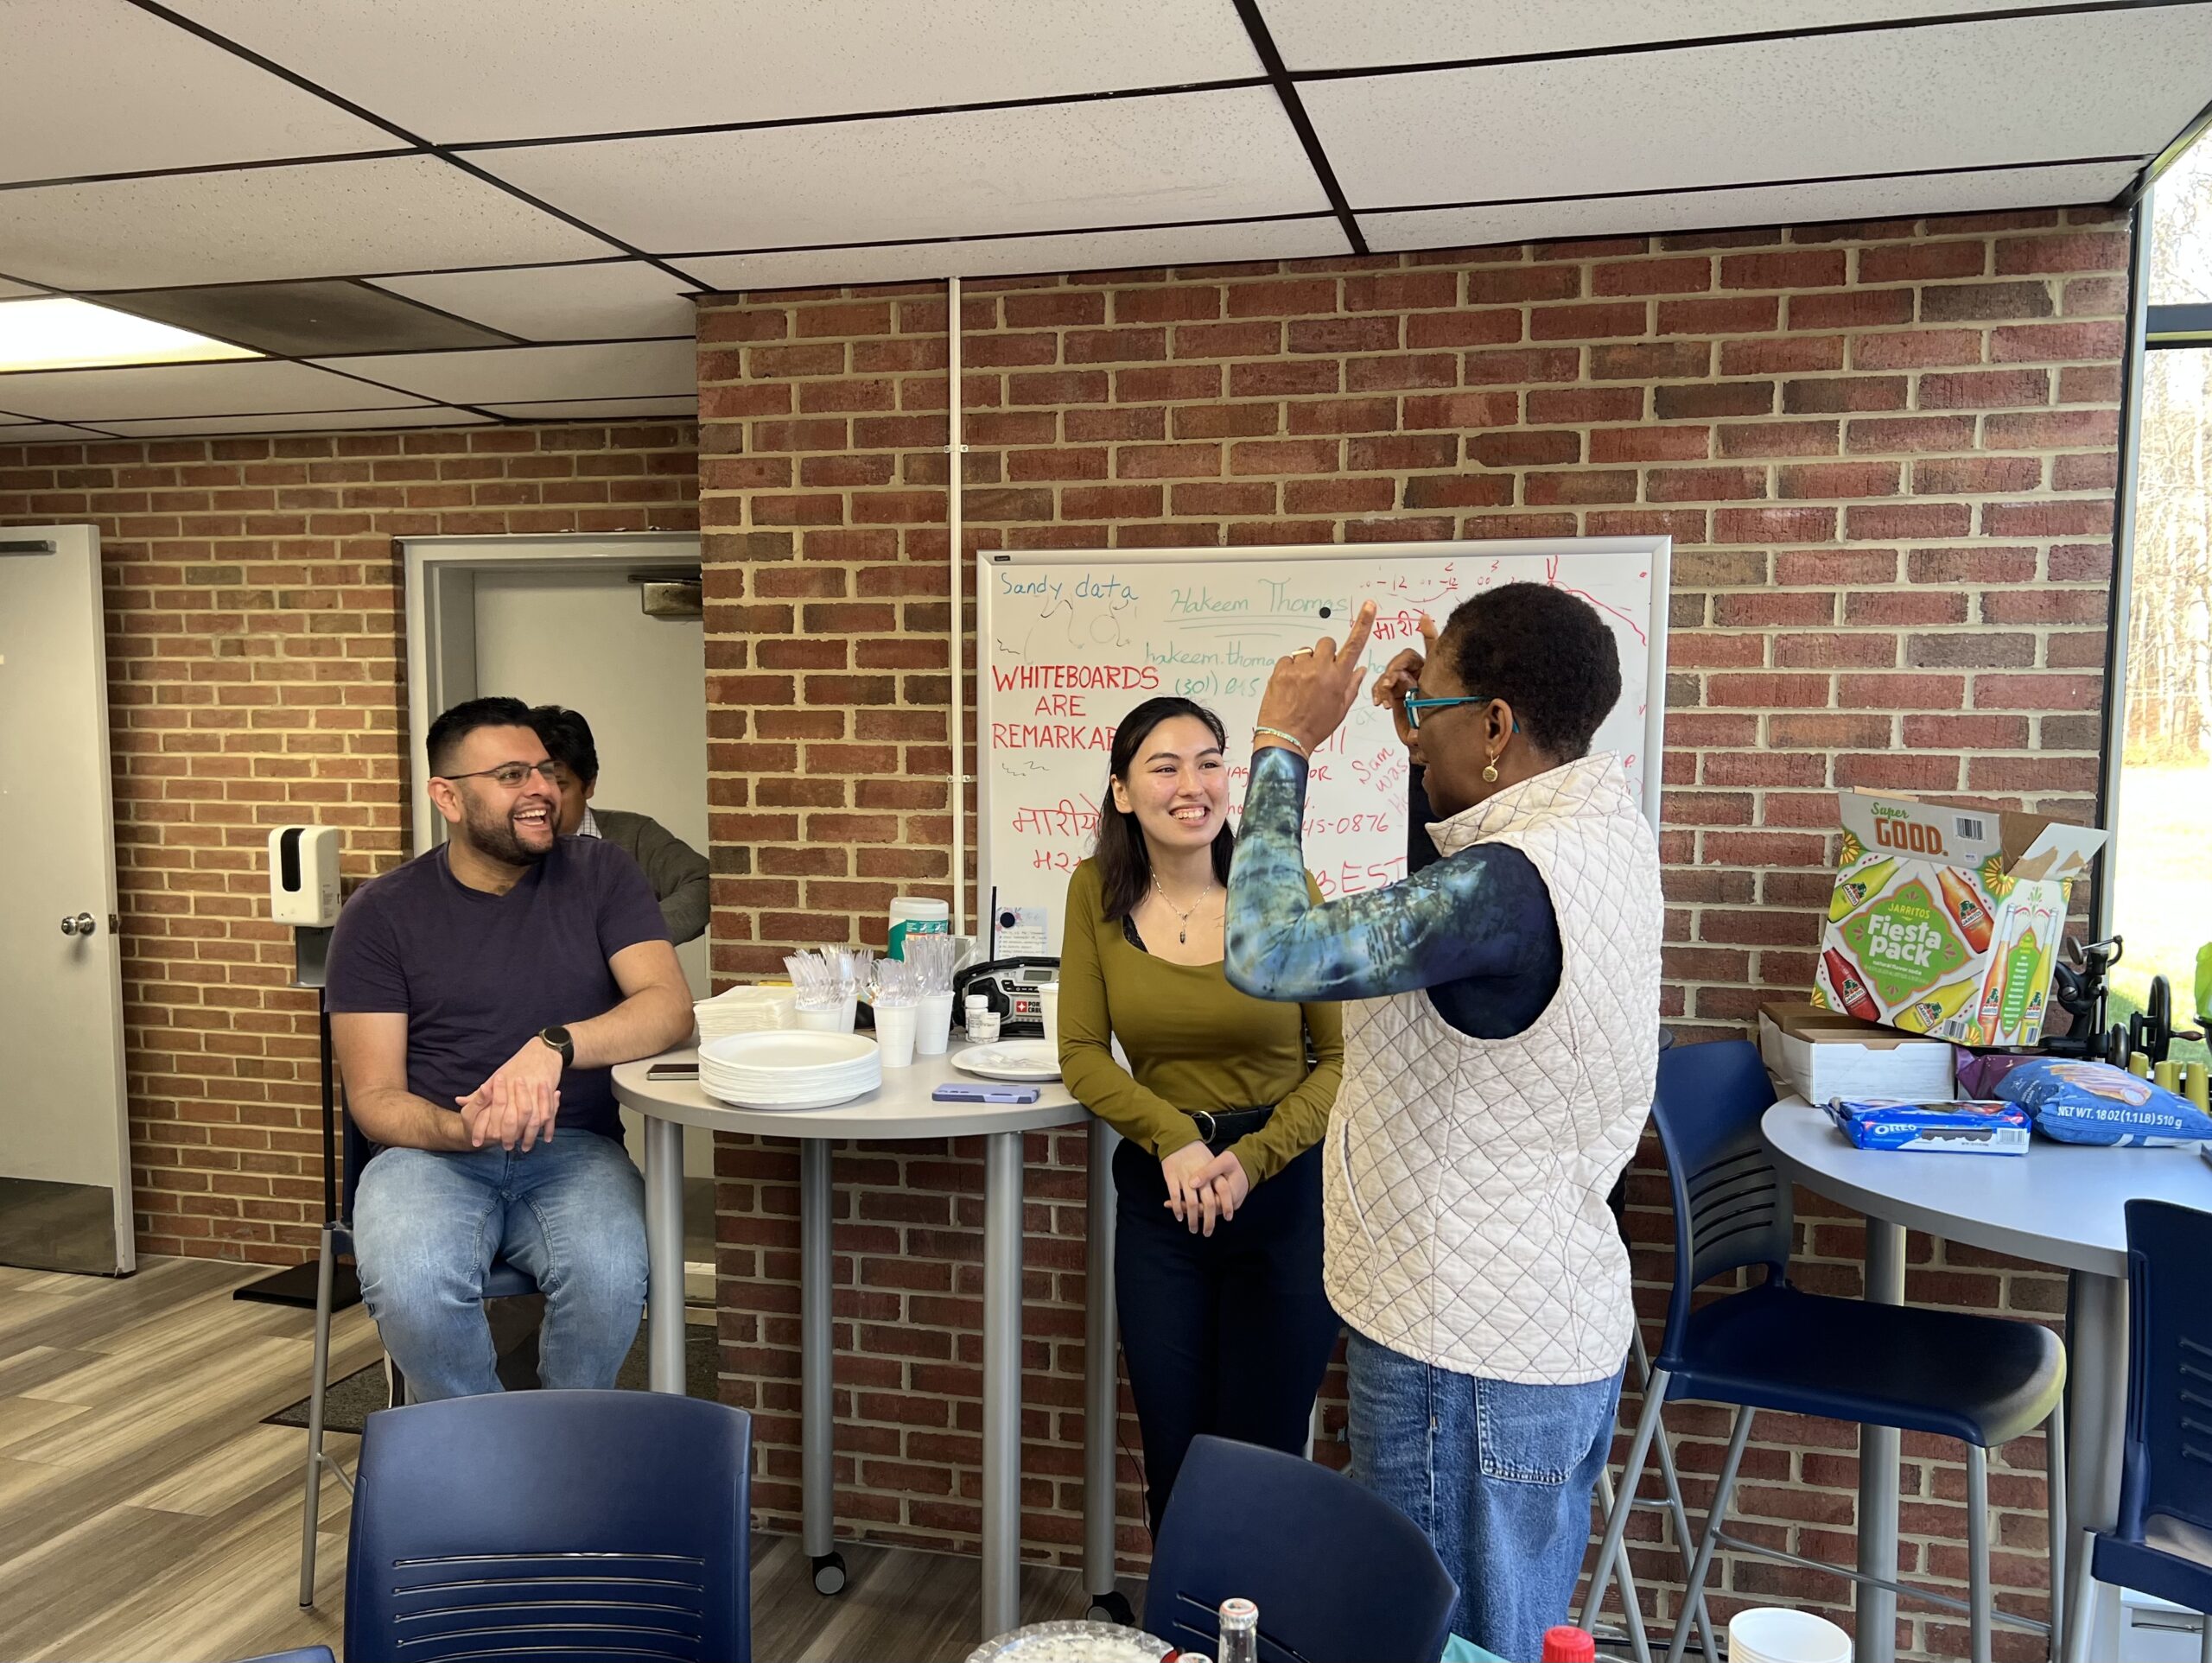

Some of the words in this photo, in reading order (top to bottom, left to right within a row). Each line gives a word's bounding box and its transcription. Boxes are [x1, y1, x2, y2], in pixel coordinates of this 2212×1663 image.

[1001, 572, 1063, 600] Sandy
[1075, 574, 1139, 600] data
[1170, 586, 1249, 614] Hakeem
[1146, 641, 1275, 668] hakeem.thoma
[992, 665, 1159, 692] WHITEBOARDS
[1175, 670, 1218, 697] (301)
[1034, 694, 1086, 717] ARE
[992, 723, 1118, 752] REMARKAB
[1351, 748, 1395, 785] Sam
[1871, 802, 1910, 819] Super
[1875, 817, 1949, 857] GOOD.
[1315, 856, 1408, 897] BEST
[1887, 902, 1931, 919] JARRITOS
[1867, 913, 1942, 950] Fiesta
[1868, 935, 1932, 968] pack
[1873, 1123, 1917, 1135] OREO
[2057, 1106, 2075, 1117] NET
[2076, 1108, 2094, 1120] WT.
[2095, 1109, 2107, 1120] 18
[2107, 1110, 2119, 1121] OZ
[2120, 1109, 2139, 1123] (1.1
[2139, 1112, 2156, 1126] LB)
[2157, 1114, 2175, 1127] 510
[2175, 1118, 2183, 1130] g
